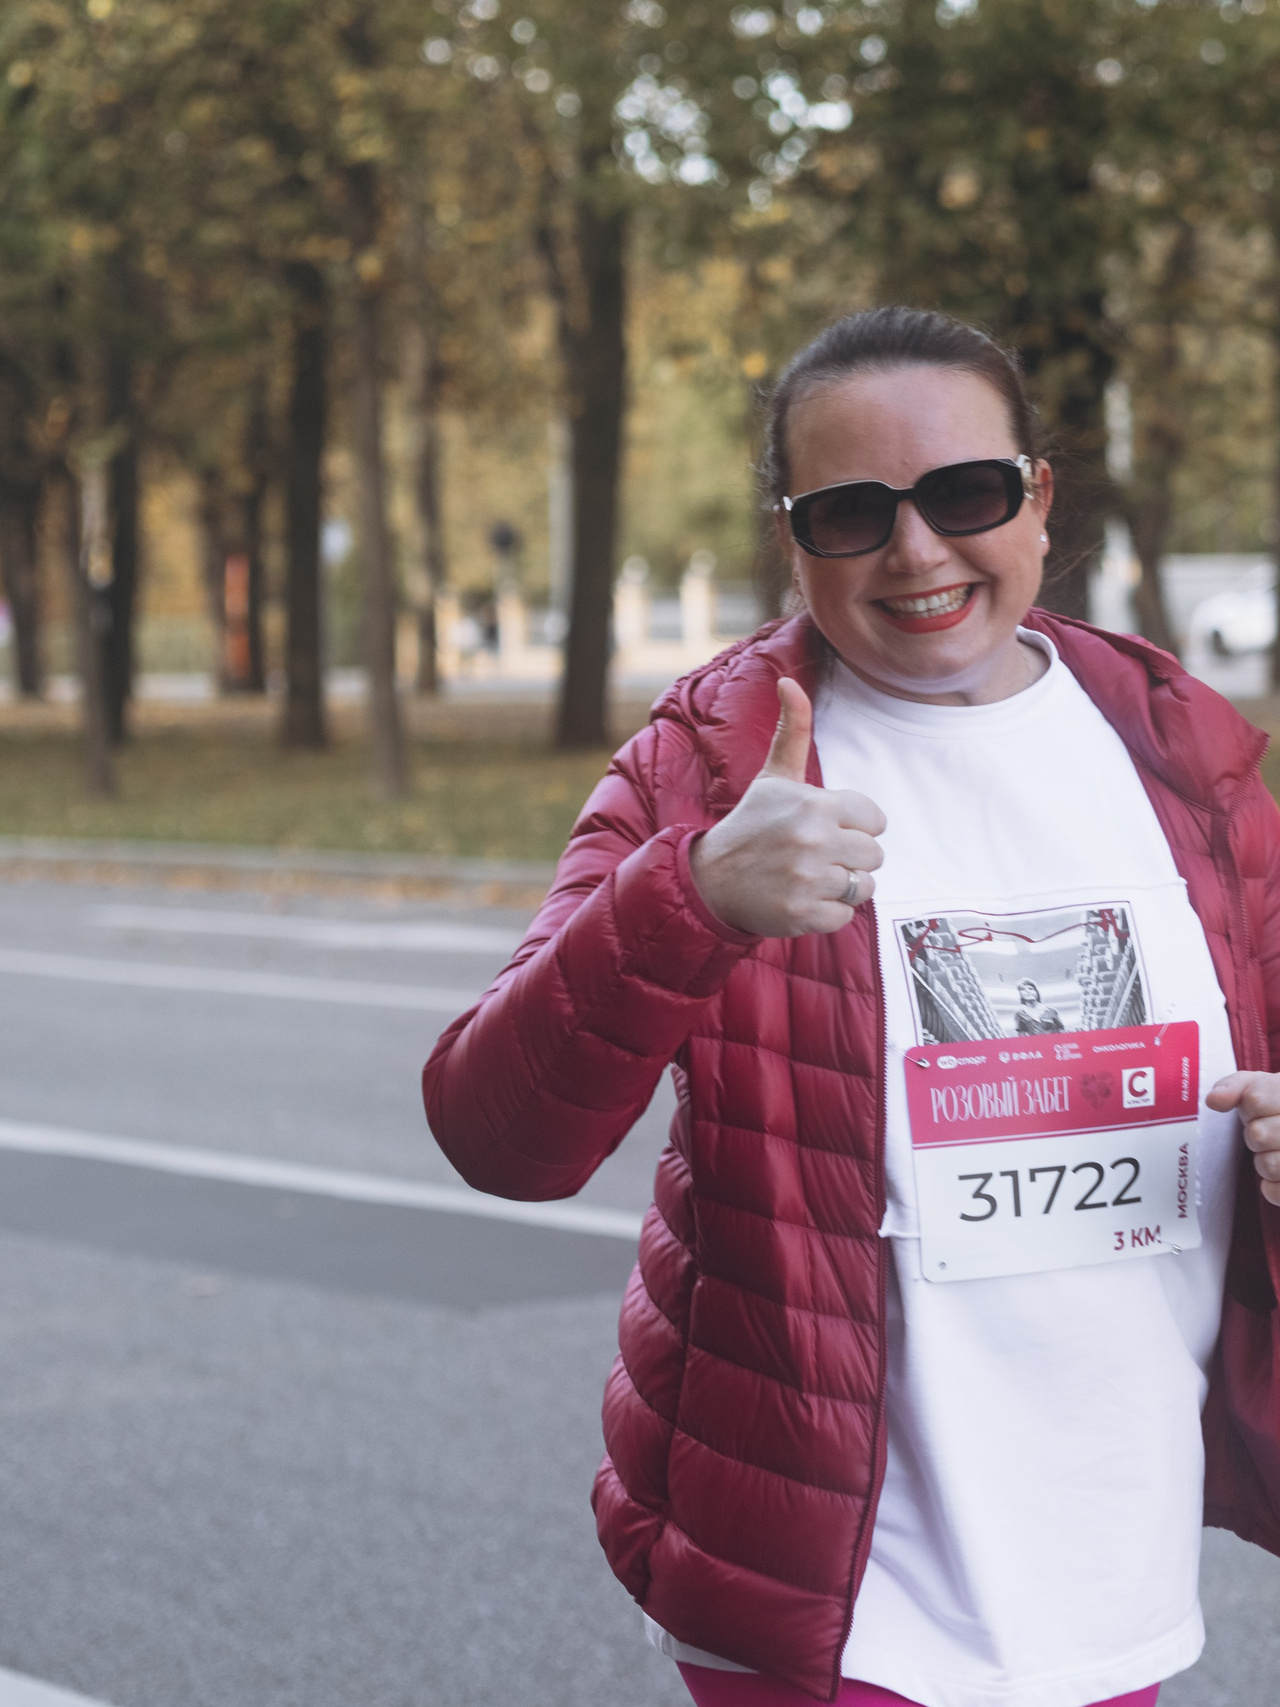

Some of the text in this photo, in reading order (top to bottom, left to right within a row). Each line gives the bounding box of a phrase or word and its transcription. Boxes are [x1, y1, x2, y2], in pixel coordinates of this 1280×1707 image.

[929, 1075, 1072, 1124] РОЗОВЫЙ ЗАБЕГ
[957, 1156, 1142, 1223] 31722
[1177, 1141, 1190, 1220] МОСКВА
[1113, 1224, 1163, 1251] 3 КМ
